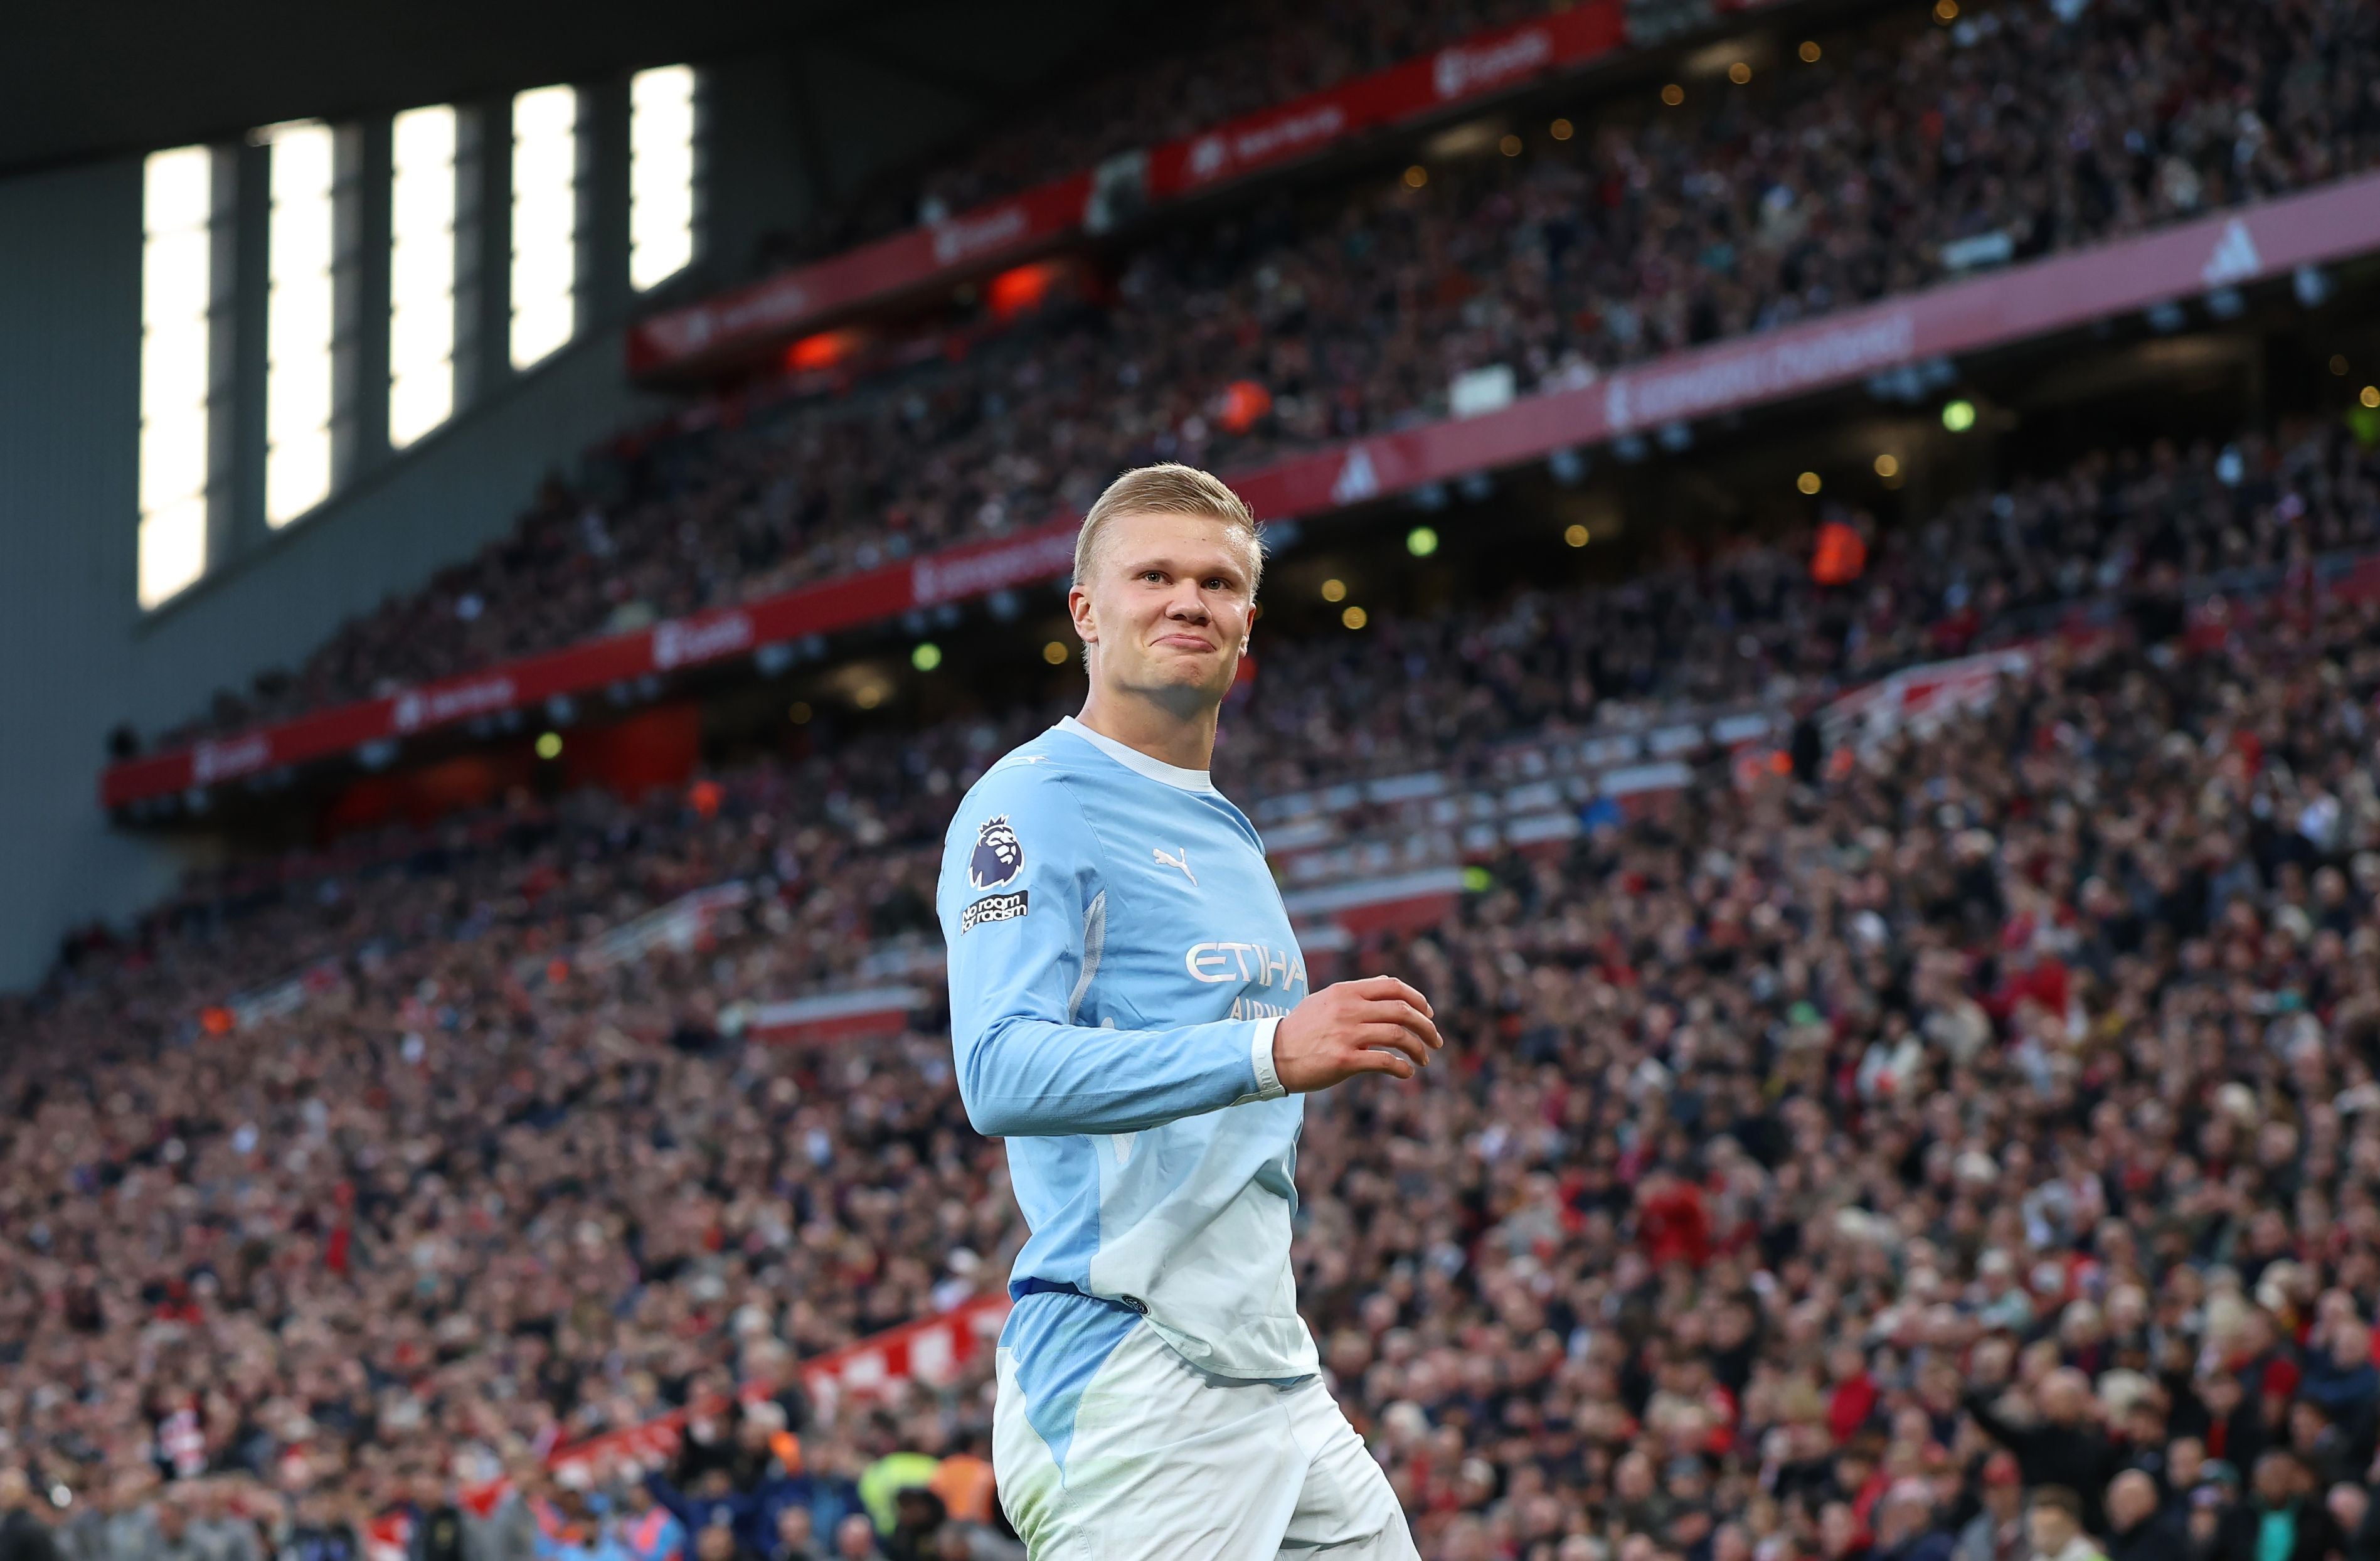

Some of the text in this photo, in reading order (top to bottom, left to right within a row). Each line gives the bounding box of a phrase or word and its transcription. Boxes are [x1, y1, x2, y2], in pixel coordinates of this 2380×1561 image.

[962, 895, 1020, 920] No room
[977, 904, 1027, 923] racism
[1186, 942, 1309, 997] ETIHA
